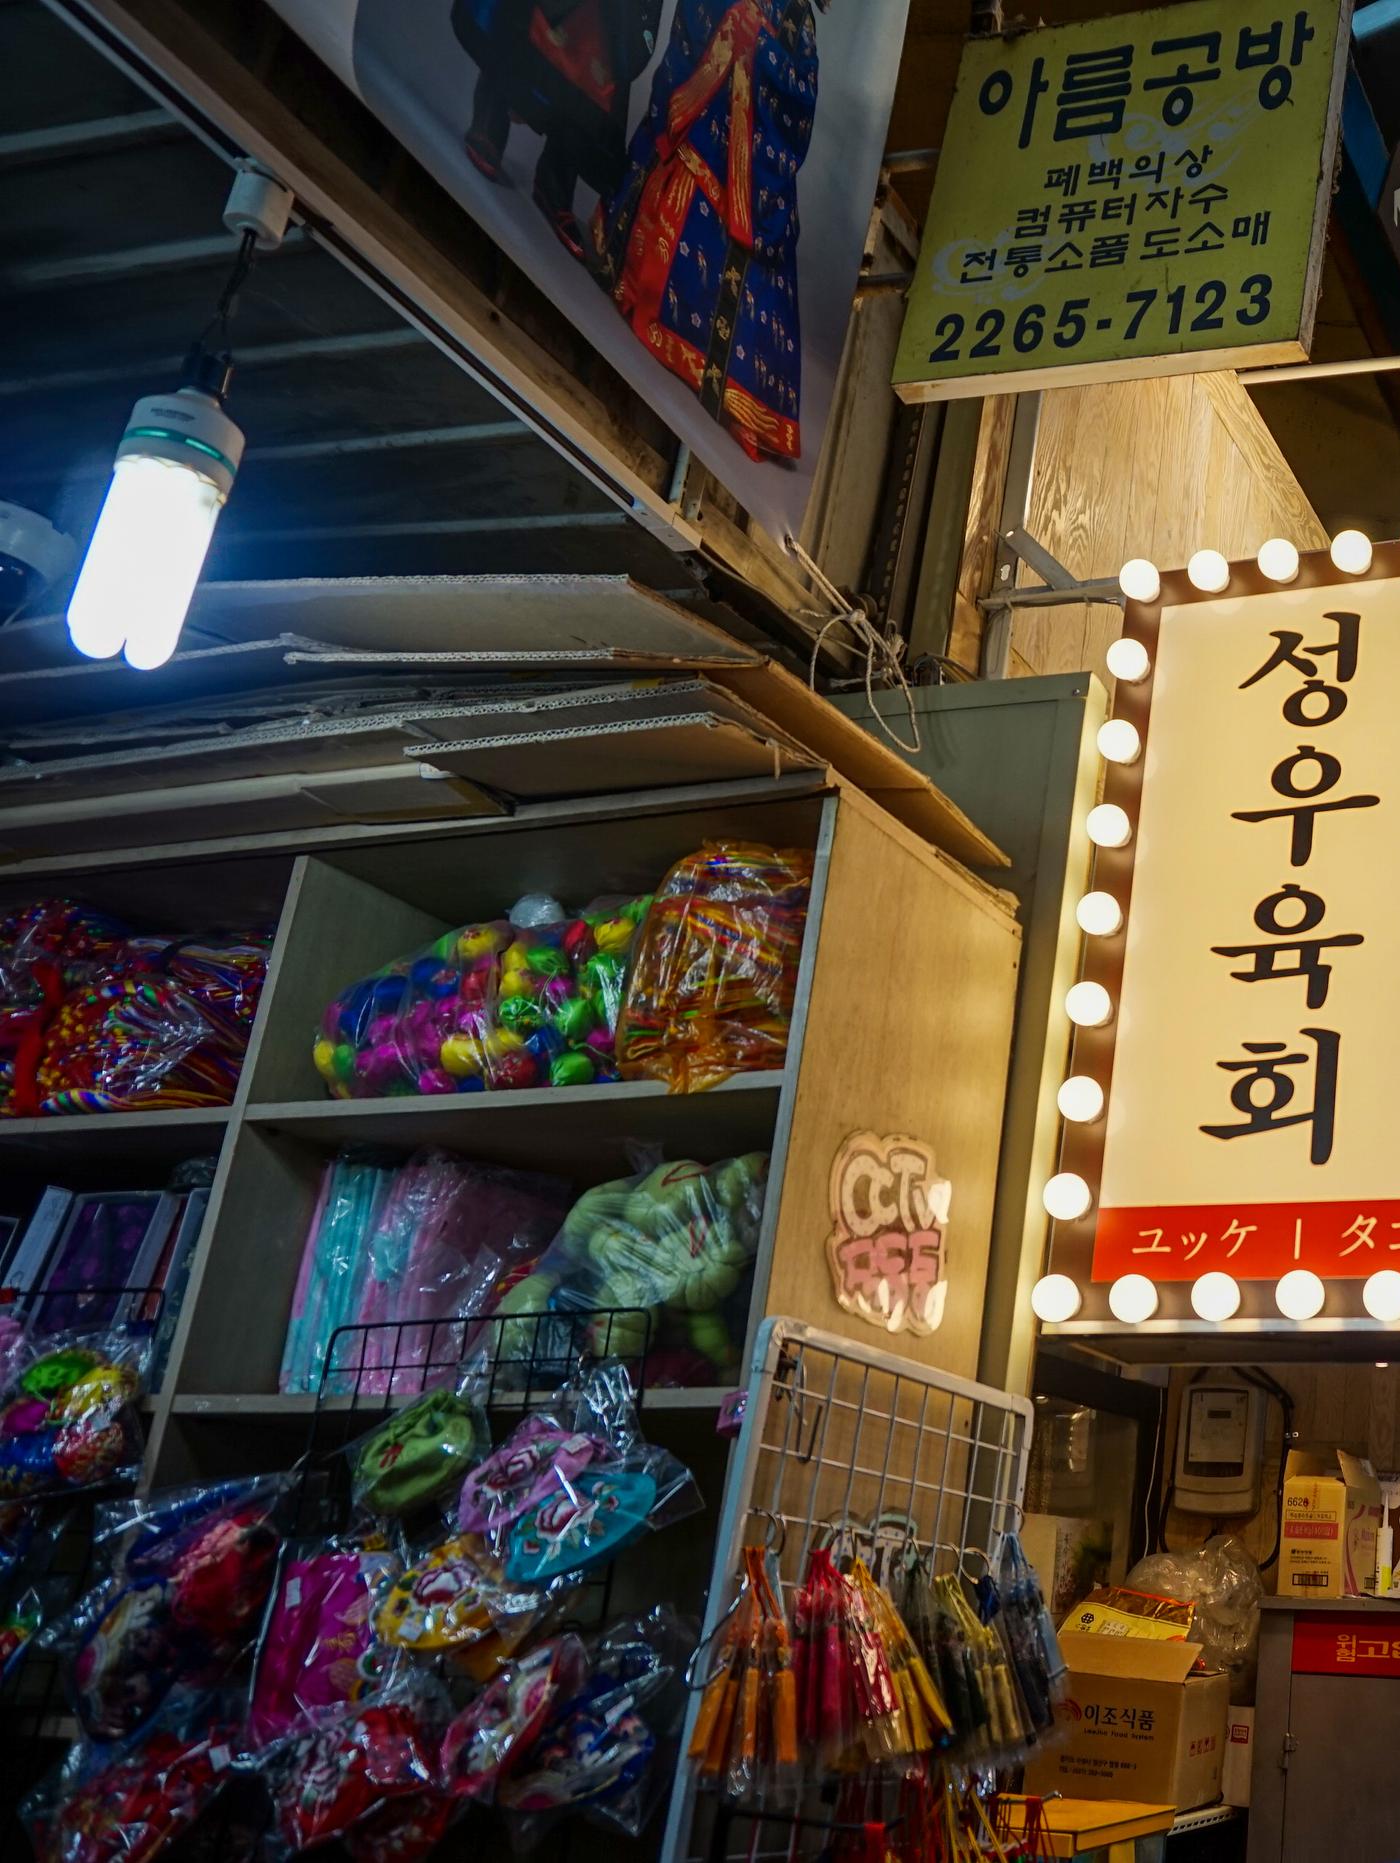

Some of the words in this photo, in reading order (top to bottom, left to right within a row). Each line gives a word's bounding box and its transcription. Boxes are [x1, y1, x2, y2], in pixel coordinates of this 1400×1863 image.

[978, 11, 1315, 149] 아름공방
[928, 273, 1274, 364] 2265-7123
[1199, 611, 1381, 1167] 성우육회
[1131, 1219, 1259, 1264] ユッケ
[1084, 1704, 1155, 1731] 이조식품
